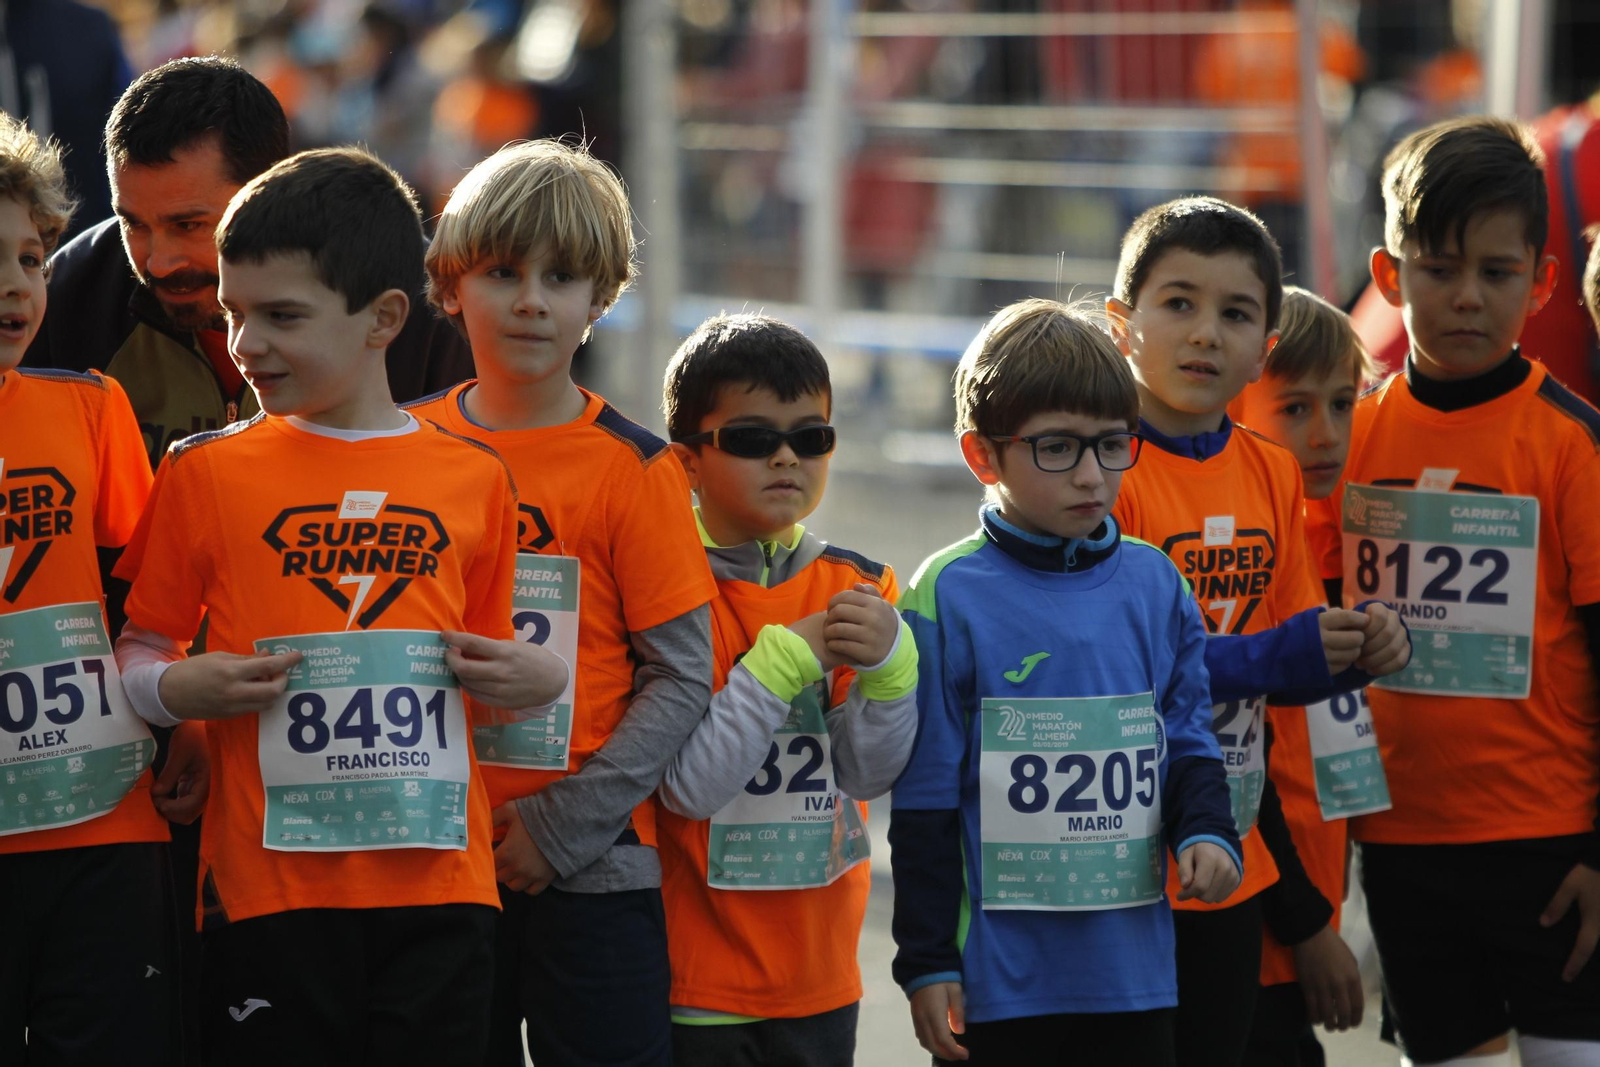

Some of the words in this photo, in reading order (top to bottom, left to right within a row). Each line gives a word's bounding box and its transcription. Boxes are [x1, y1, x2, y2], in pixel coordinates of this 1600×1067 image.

[297, 522, 427, 549] SUPER
[1452, 524, 1520, 538] INFANTIL
[282, 549, 438, 578] RUNNER
[1184, 545, 1263, 574] SUPER
[1357, 539, 1510, 605] 8122
[55, 617, 95, 632] CARRERA
[62, 634, 100, 648] INFANTIL
[308, 647, 341, 657] MEDIO
[309, 655, 360, 667] MARATÓN
[310, 665, 355, 678] ALMERÍA
[287, 686, 448, 754] 8491
[1032, 712, 1063, 721] MEDIO
[1032, 721, 1082, 731] MARATÓN
[18, 729, 68, 751] ALEX
[1033, 731, 1077, 741] ALMERÍA
[0, 754, 36, 765] LEJANDRO
[38, 750, 59, 759] PEREZ
[61, 744, 92, 756] DOBARRO
[326, 751, 430, 771] FRANCISCO
[332, 773, 370, 781] FRANCISCO
[371, 771, 398, 780] PADILLA
[1008, 748, 1155, 814] 8205
[283, 793, 309, 804] NEXA
[315, 789, 336, 801] CDX
[1068, 815, 1123, 832] MARIO
[725, 831, 751, 842] NEXA
[758, 828, 780, 840] CDX
[1060, 835, 1081, 843] MARIO
[997, 851, 1024, 862] NEXA
[1030, 849, 1051, 861] CDX
